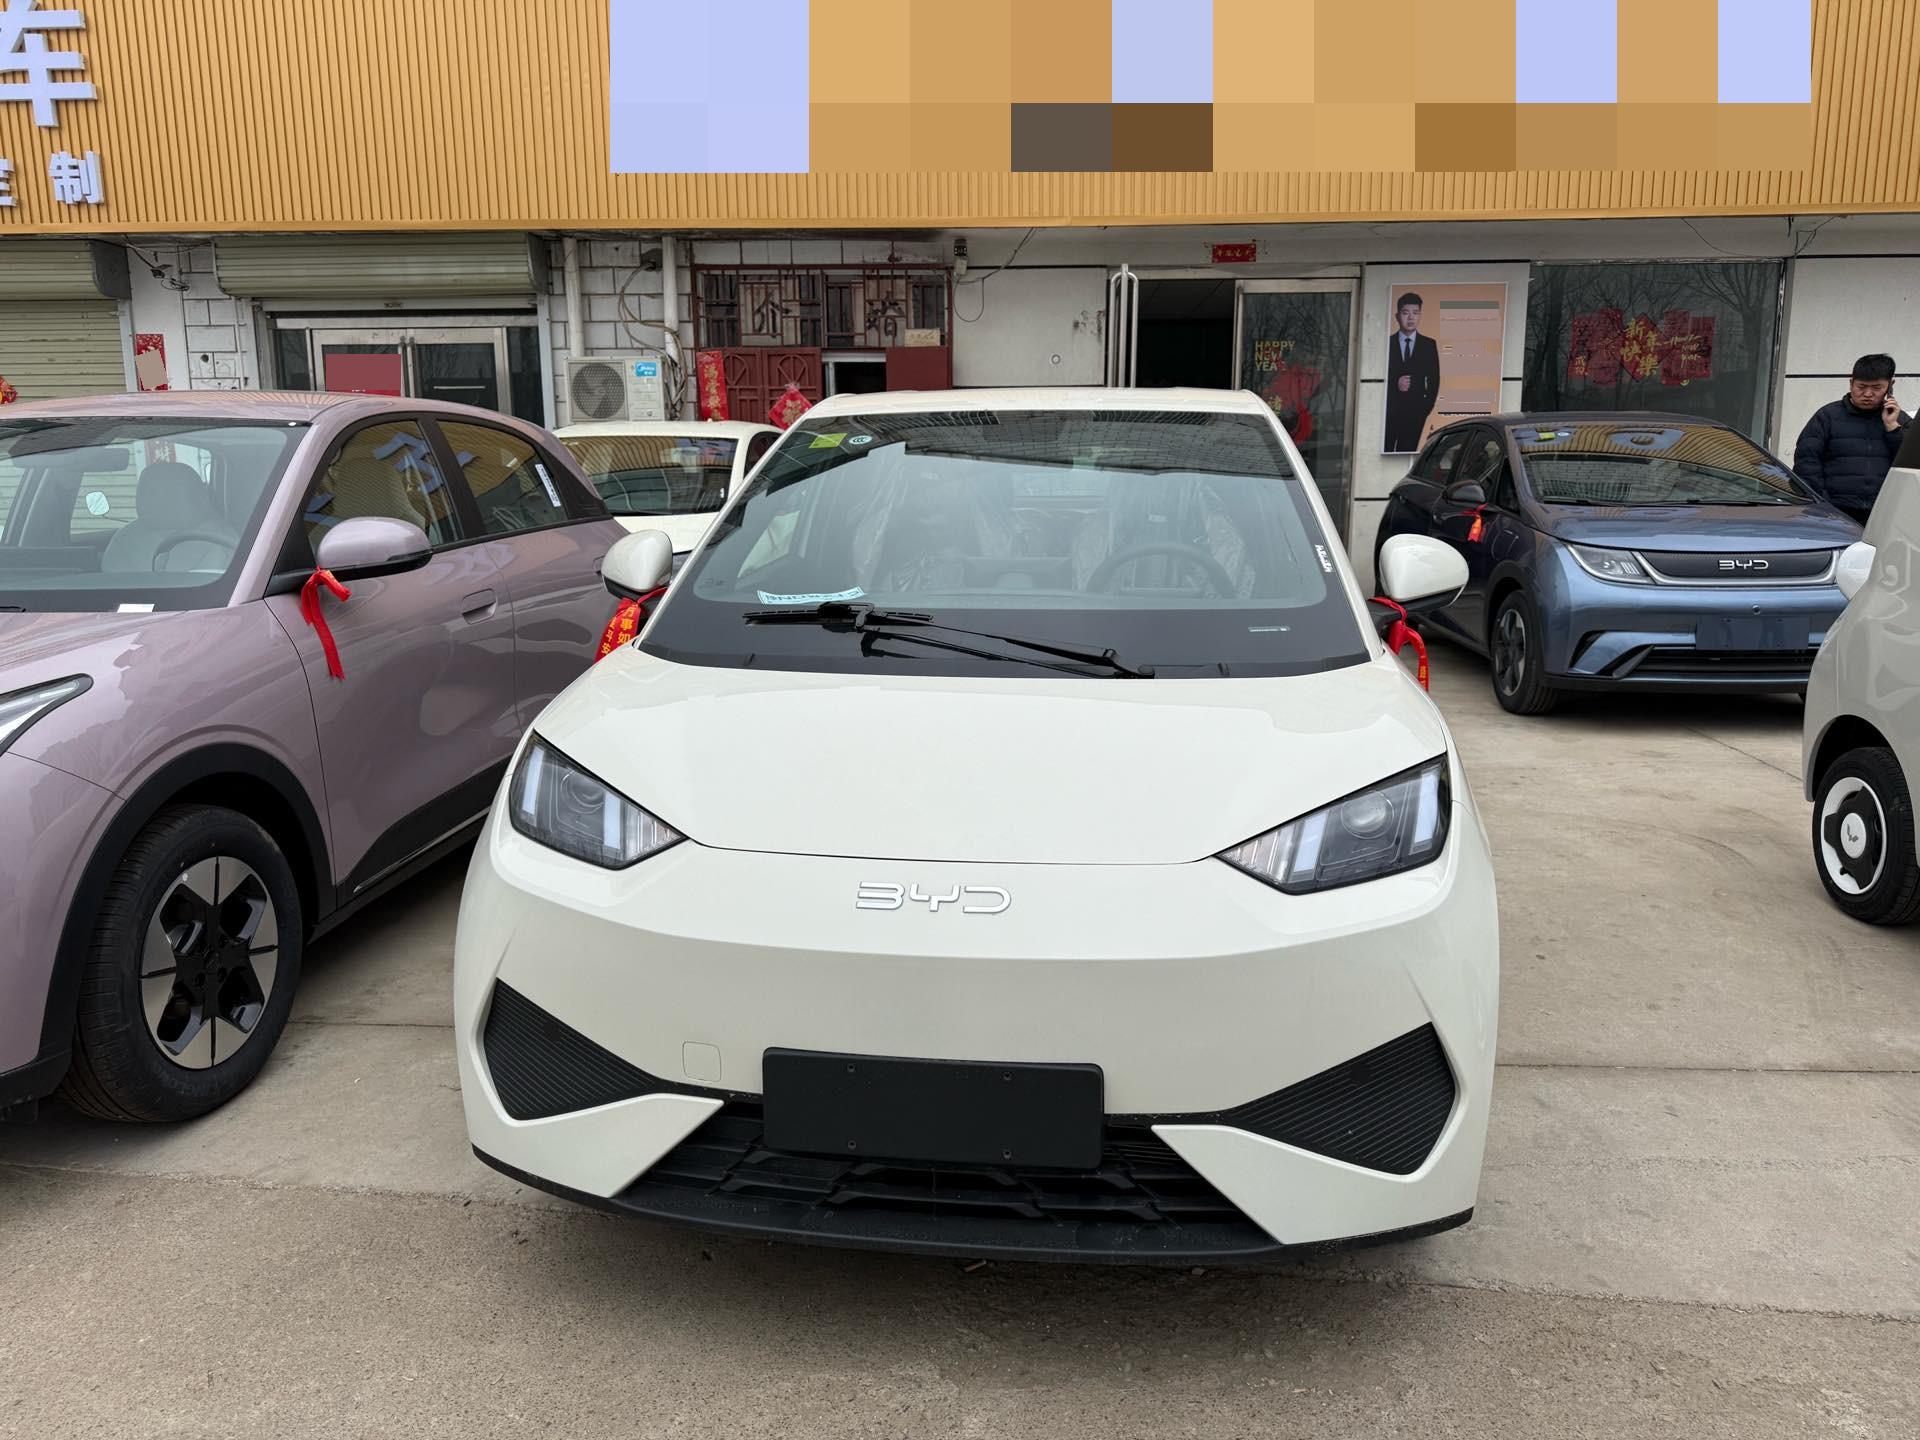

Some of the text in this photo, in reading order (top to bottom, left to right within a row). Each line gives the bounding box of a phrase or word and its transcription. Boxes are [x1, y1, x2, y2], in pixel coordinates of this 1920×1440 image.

[1624, 317, 1662, 351] 新年
[1255, 341, 1296, 351] HAPPY
[1719, 560, 1769, 569] BYD
[856, 881, 1012, 914] BYD
